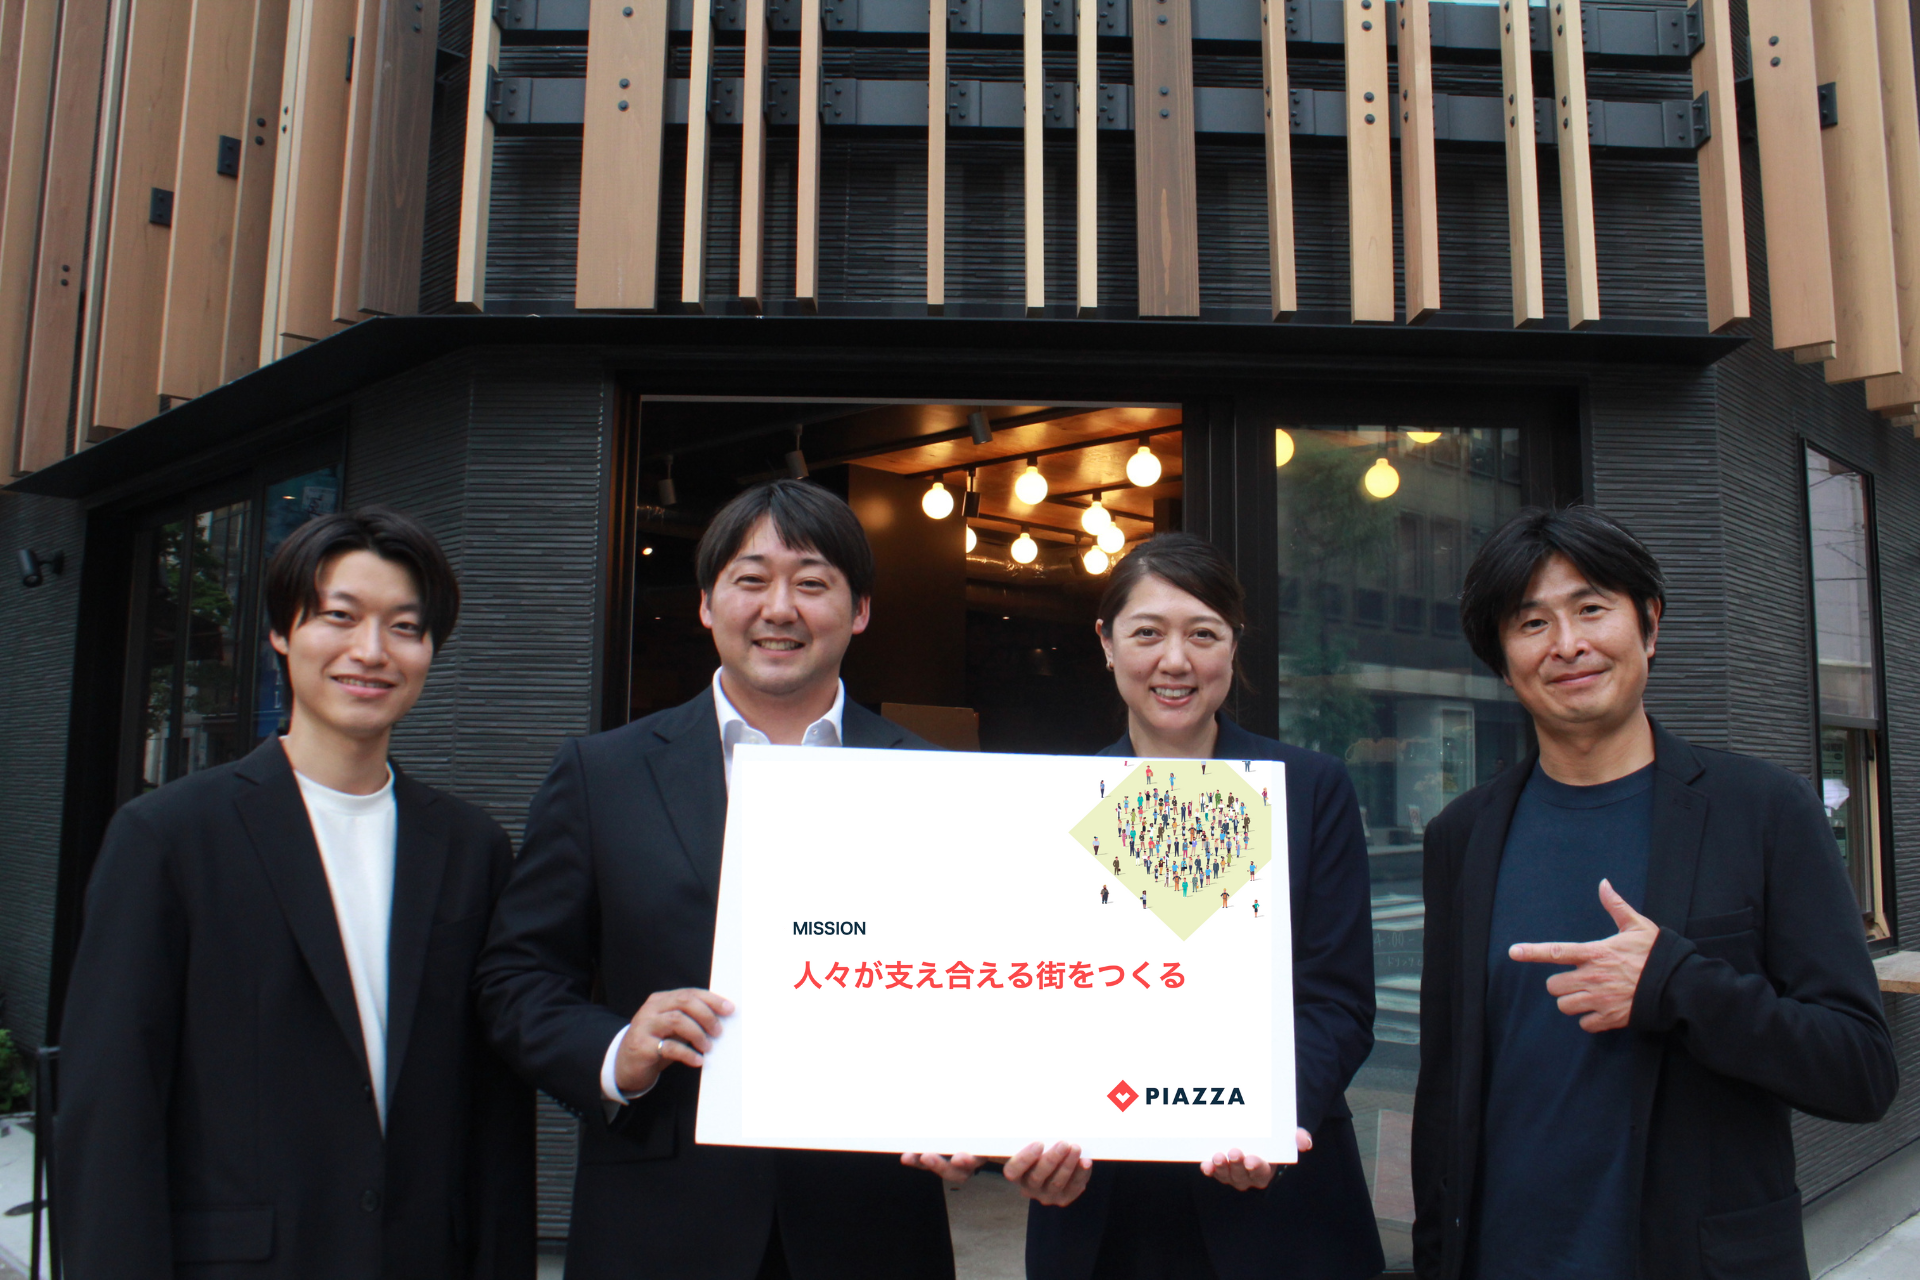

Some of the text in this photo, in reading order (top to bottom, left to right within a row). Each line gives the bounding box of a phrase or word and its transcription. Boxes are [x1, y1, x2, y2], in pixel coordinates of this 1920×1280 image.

[793, 920, 867, 936] MISSION
[793, 959, 1186, 990] 人々が支え合える街をつくる
[1145, 1087, 1246, 1106] PIAZZA
